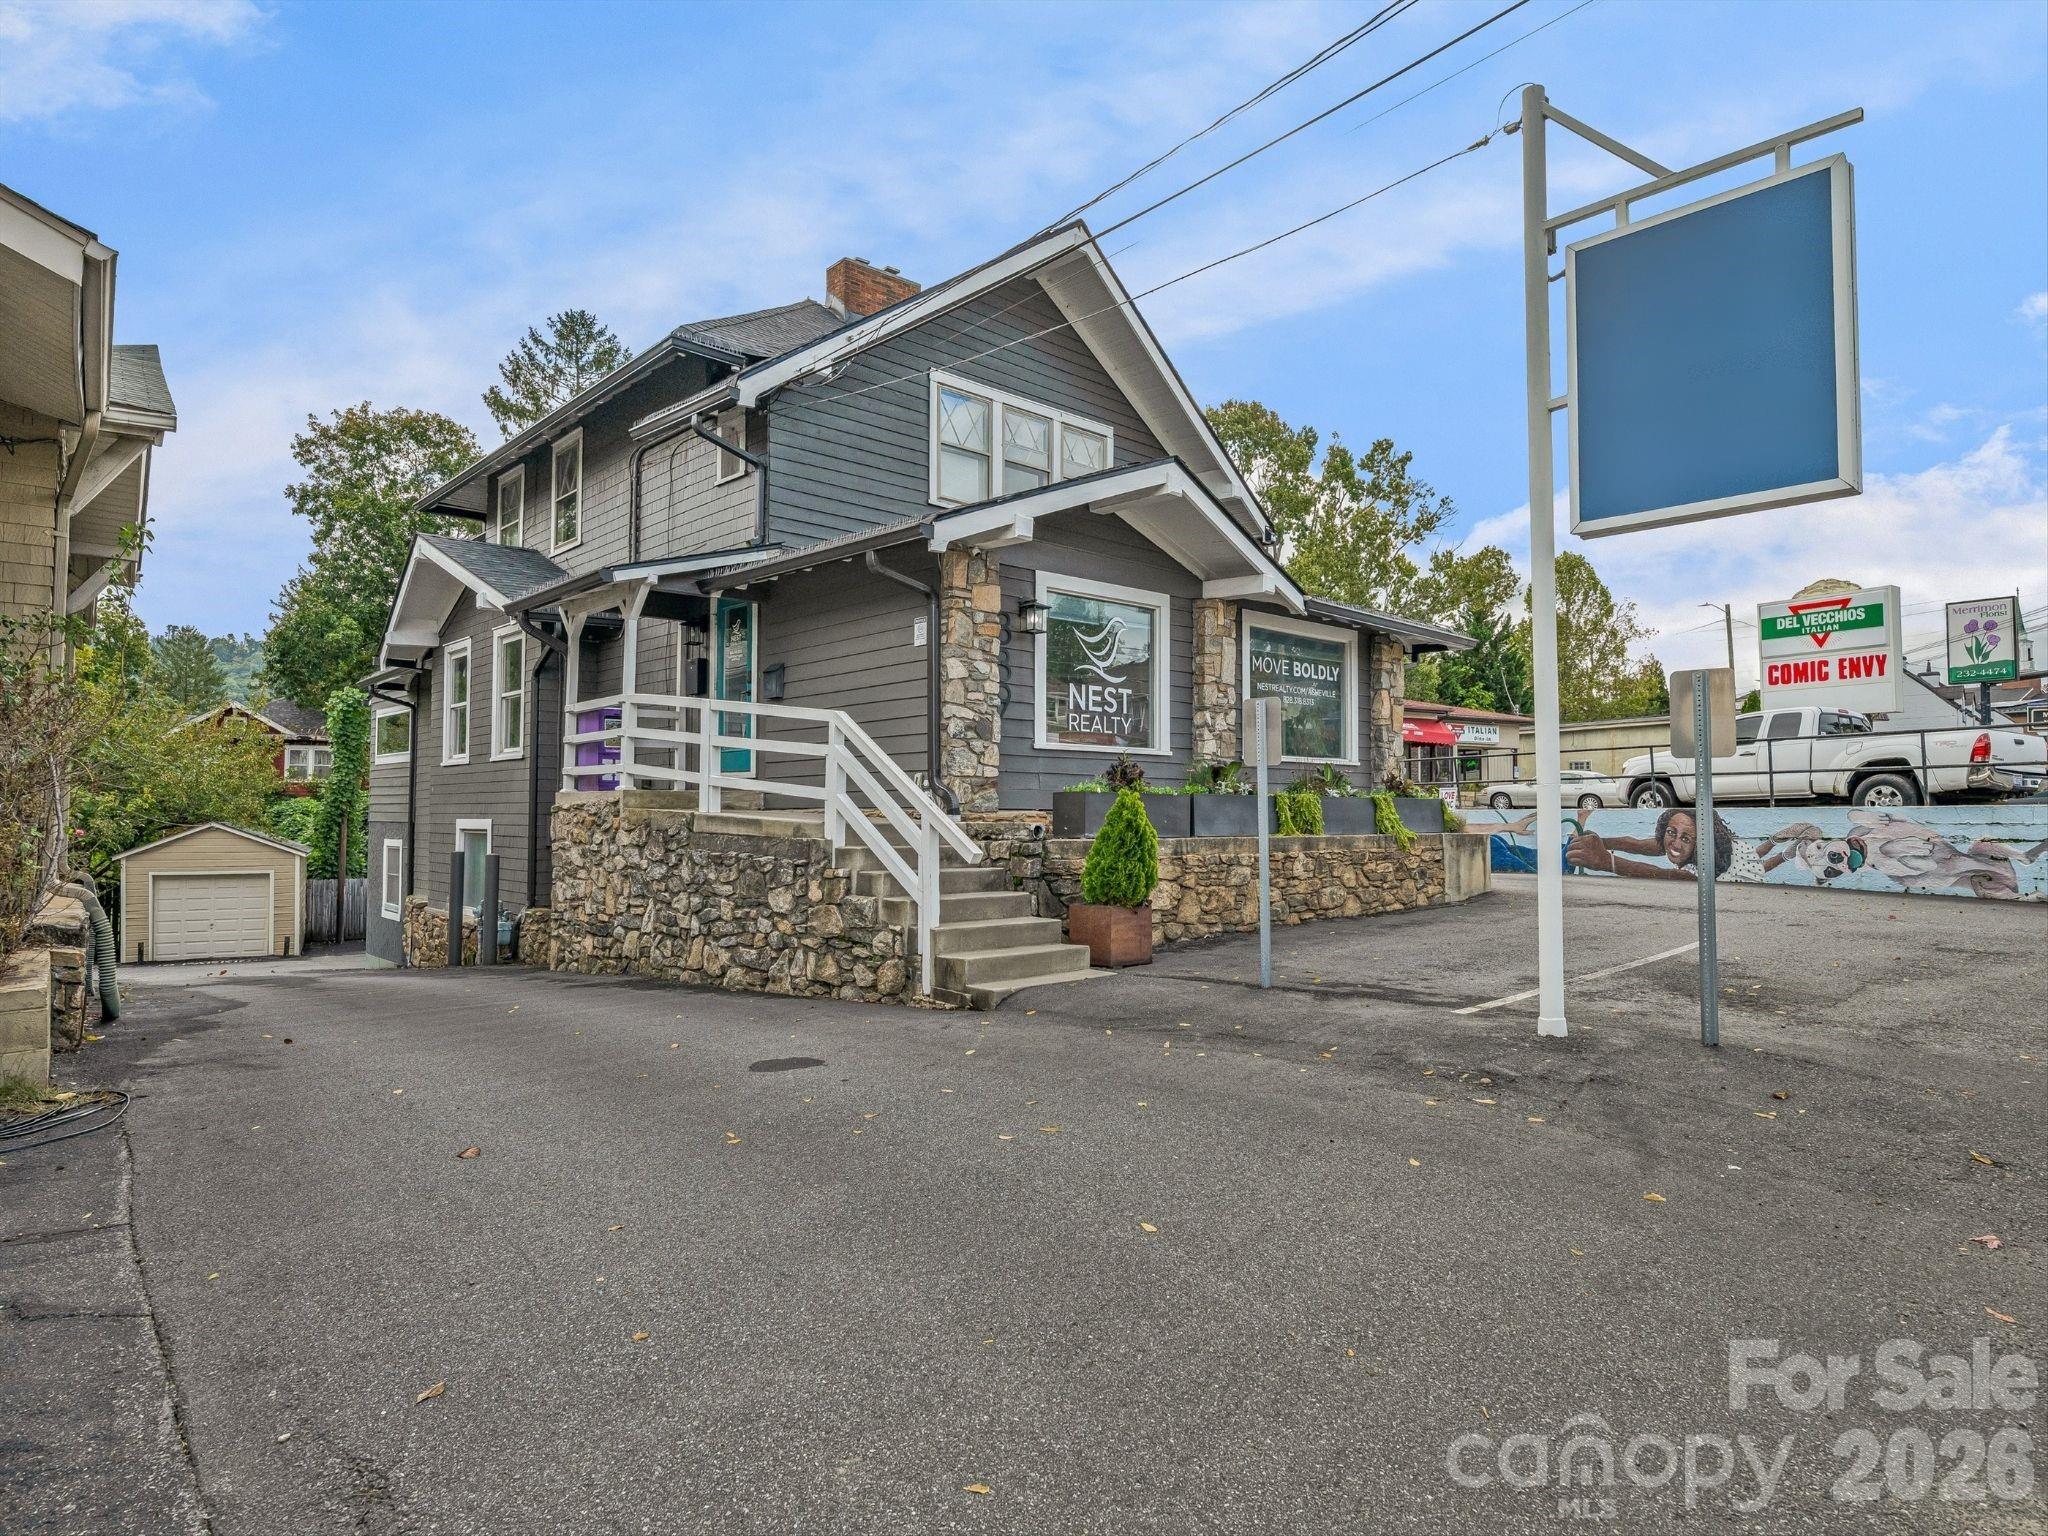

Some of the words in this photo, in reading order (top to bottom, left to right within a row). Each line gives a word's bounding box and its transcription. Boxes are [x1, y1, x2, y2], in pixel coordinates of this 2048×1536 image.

[1952, 603, 2007, 616] Merrimon
[1980, 610, 2008, 618] Florist
[1776, 617, 1800, 630] DEL
[1802, 607, 1866, 627] VECCHIOS
[1802, 624, 1840, 634] ITALIAN
[1252, 656, 1290, 676] MOVE
[1293, 662, 1340, 682] BOLDLY
[1767, 659, 1830, 686] COMIC
[1837, 654, 1888, 680] ENVY
[1956, 667, 2007, 678] 232-4474
[1069, 682, 1132, 714] NEST
[1069, 713, 1132, 735] REALTY
[1467, 726, 1497, 735] ITALIAN
